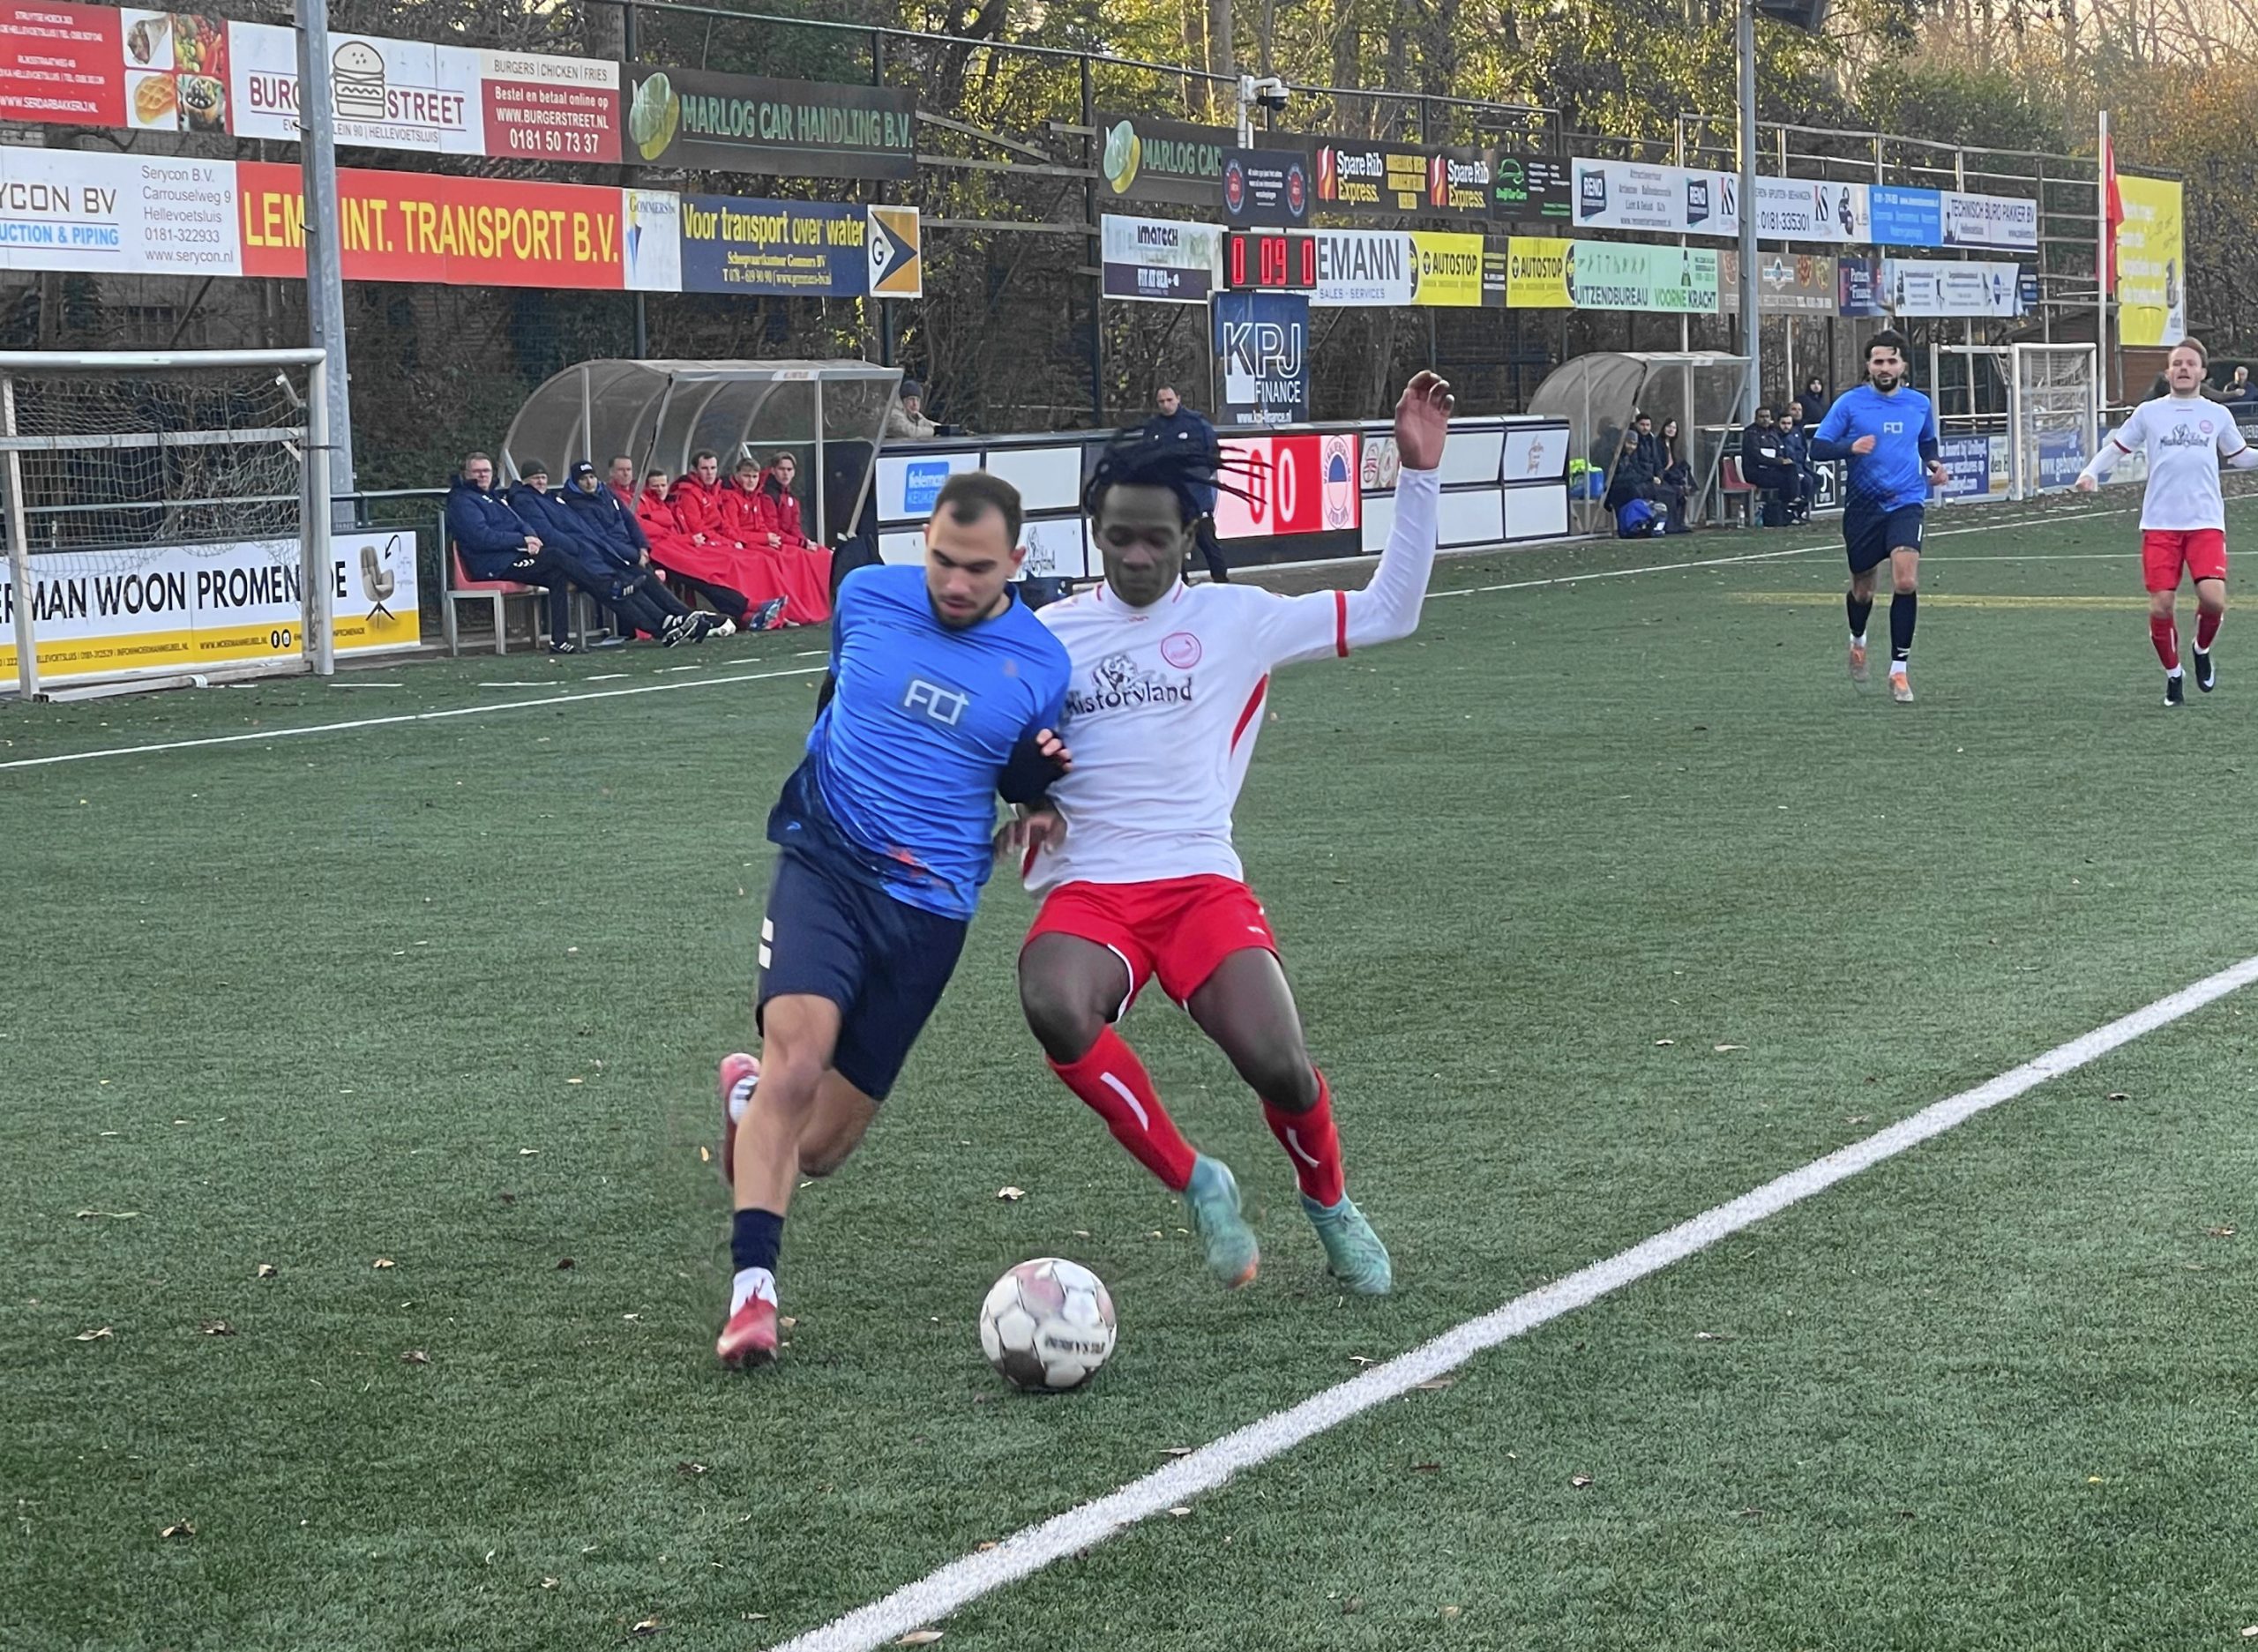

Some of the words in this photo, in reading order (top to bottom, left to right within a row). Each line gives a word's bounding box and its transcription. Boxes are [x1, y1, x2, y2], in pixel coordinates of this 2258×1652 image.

[494, 59, 535, 76] BURGERS
[541, 64, 578, 79] CHICKEN
[584, 66, 608, 81] FRIES
[387, 89, 466, 125] STREET
[495, 86, 524, 101] Bestel
[526, 91, 537, 102] en
[539, 89, 567, 104] betaal
[569, 93, 595, 107] online
[597, 97, 609, 110] op
[496, 107, 609, 129] WWW.BURGERSTREET.NL
[682, 94, 755, 138] MARLOG
[759, 102, 794, 140] CAR
[797, 105, 880, 146] HANDLING
[885, 112, 914, 148] B.V.
[510, 128, 541, 150] 0181
[545, 131, 562, 151] 50
[564, 132, 580, 153] 73
[583, 134, 599, 153] 37
[1142, 138, 1194, 174] MARLOG
[1337, 151, 1365, 179] Spare
[1366, 153, 1383, 176] Rib
[141, 165, 188, 183] Serycon
[192, 168, 214, 183] B.V.
[1447, 159, 1474, 187] Spare
[1474, 160, 1490, 184] Rib
[143, 186, 221, 205] Carrouselweg
[224, 190, 231, 203] 9
[1584, 176, 1604, 197] RENO
[1689, 186, 1707, 206] RENO
[1721, 177, 1736, 215] KS
[84, 188, 116, 214] BV
[1814, 185, 1828, 221] KS
[1951, 198, 1984, 219] TECHNISCH
[144, 206, 221, 222] Hellevoetsluis
[58, 226, 67, 243] &
[72, 227, 119, 245] PIPING
[145, 228, 220, 243] 0181-322933
[341, 198, 393, 252] INT.
[400, 201, 565, 260] TRANSPORT
[573, 211, 618, 263] B.V.
[682, 203, 717, 240] Voor
[721, 206, 789, 250] transport
[792, 217, 823, 245] over
[826, 213, 866, 247] water
[145, 250, 233, 265] www.serycon.nl
[1232, 237, 1245, 284] 0
[1432, 252, 1477, 276] AUTOSTOP
[1521, 257, 1563, 279] AUTOSTOP
[1320, 288, 1343, 299] SALES
[1350, 288, 1385, 299] SERVICES
[1575, 285, 1649, 306] UITZENDBUREAU
[1655, 288, 1686, 307] VOORNE
[1687, 289, 1716, 309] KRACHT
[1223, 322, 1301, 378] KPJ
[1255, 380, 1301, 403] FINANCE
[1279, 448, 1297, 522] 0
[94, 572, 185, 616] WOON
